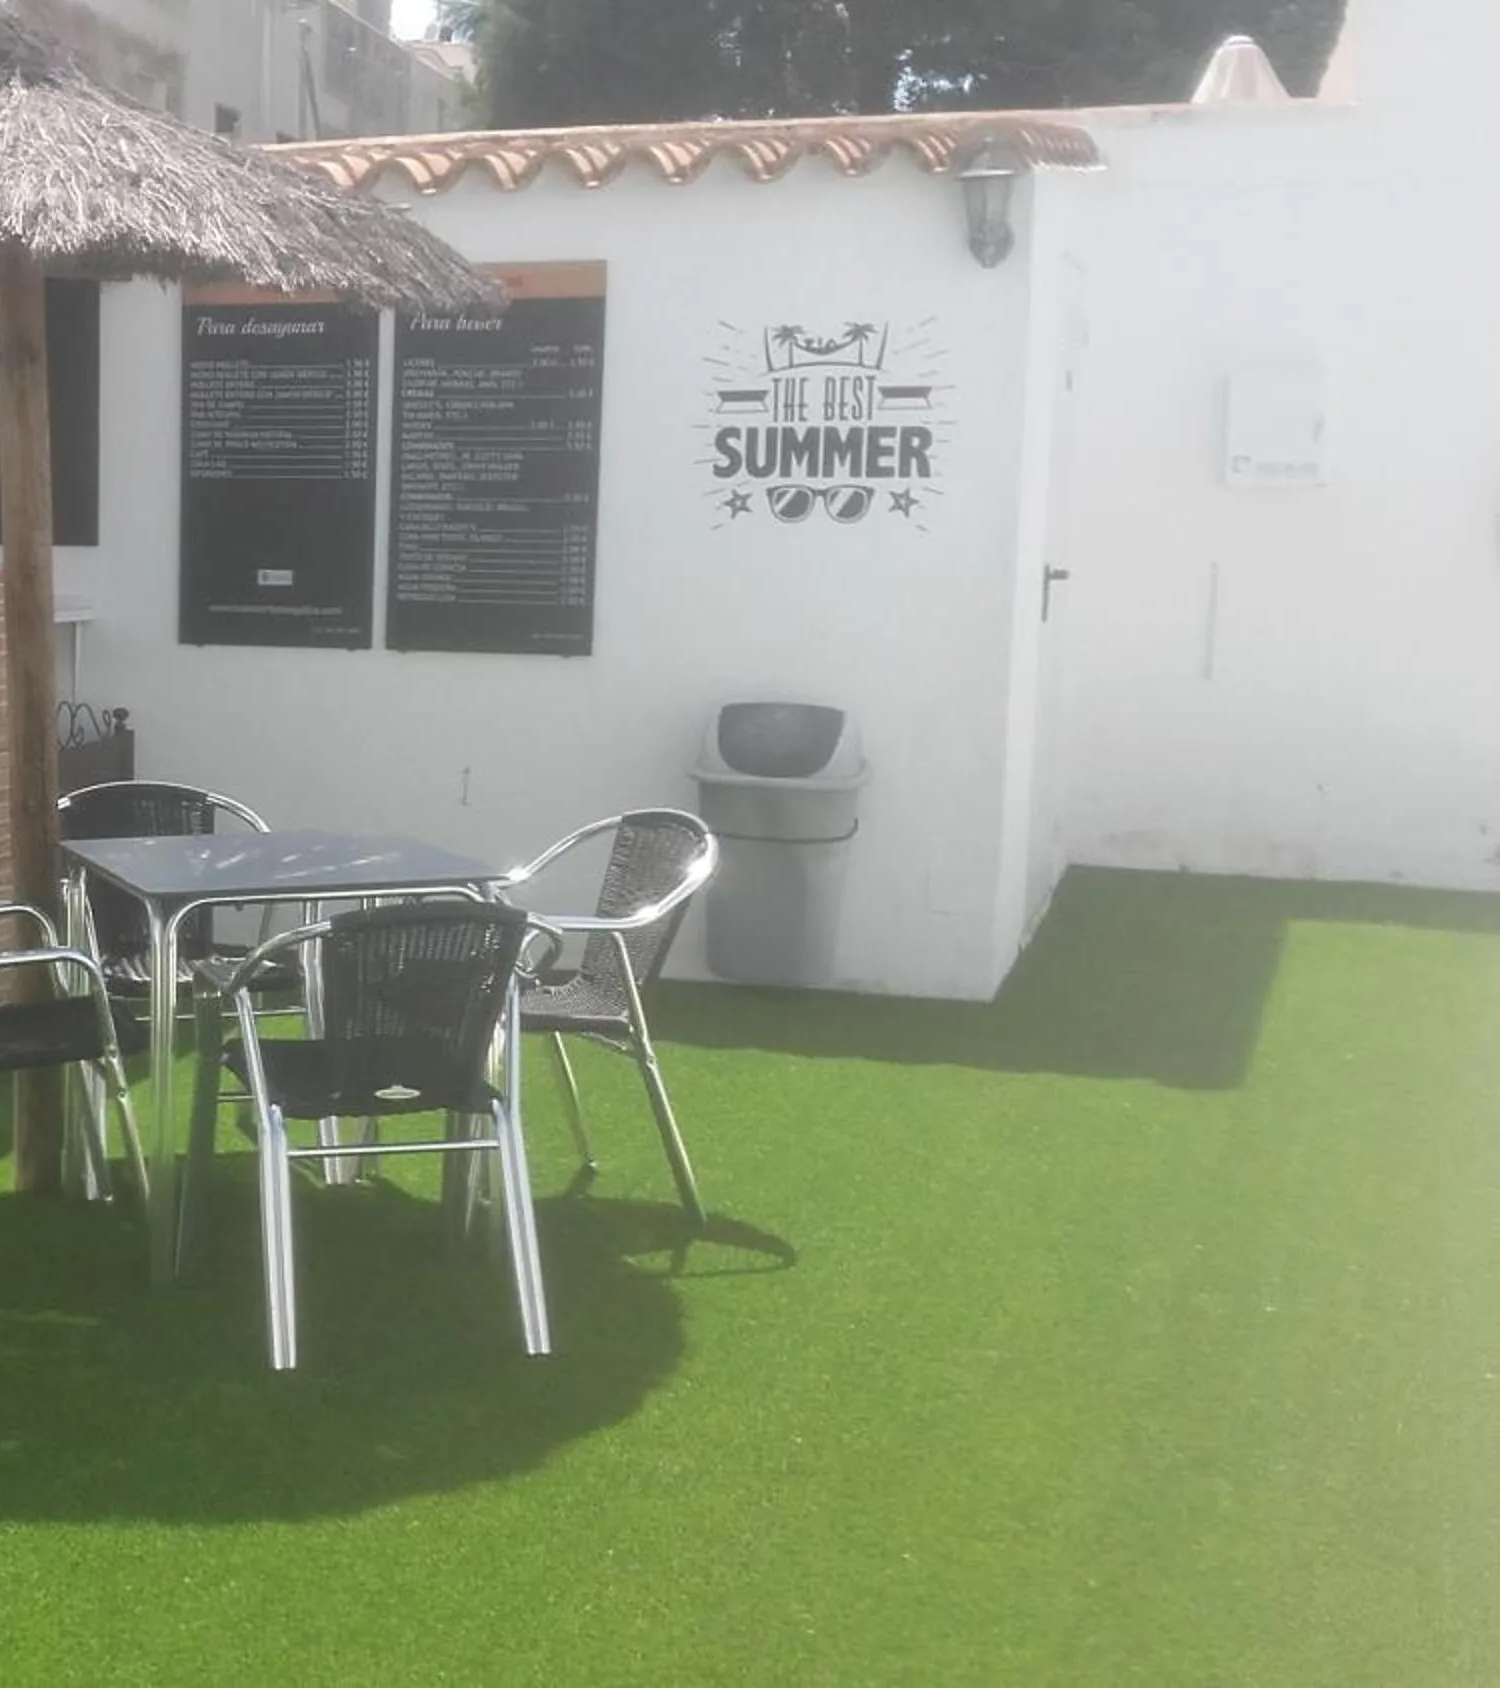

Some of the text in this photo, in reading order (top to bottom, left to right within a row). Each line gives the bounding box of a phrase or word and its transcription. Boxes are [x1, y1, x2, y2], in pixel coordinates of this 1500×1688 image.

[197, 316, 236, 336] Para
[771, 375, 878, 423] THE BEST
[711, 425, 934, 480] SUMMER
